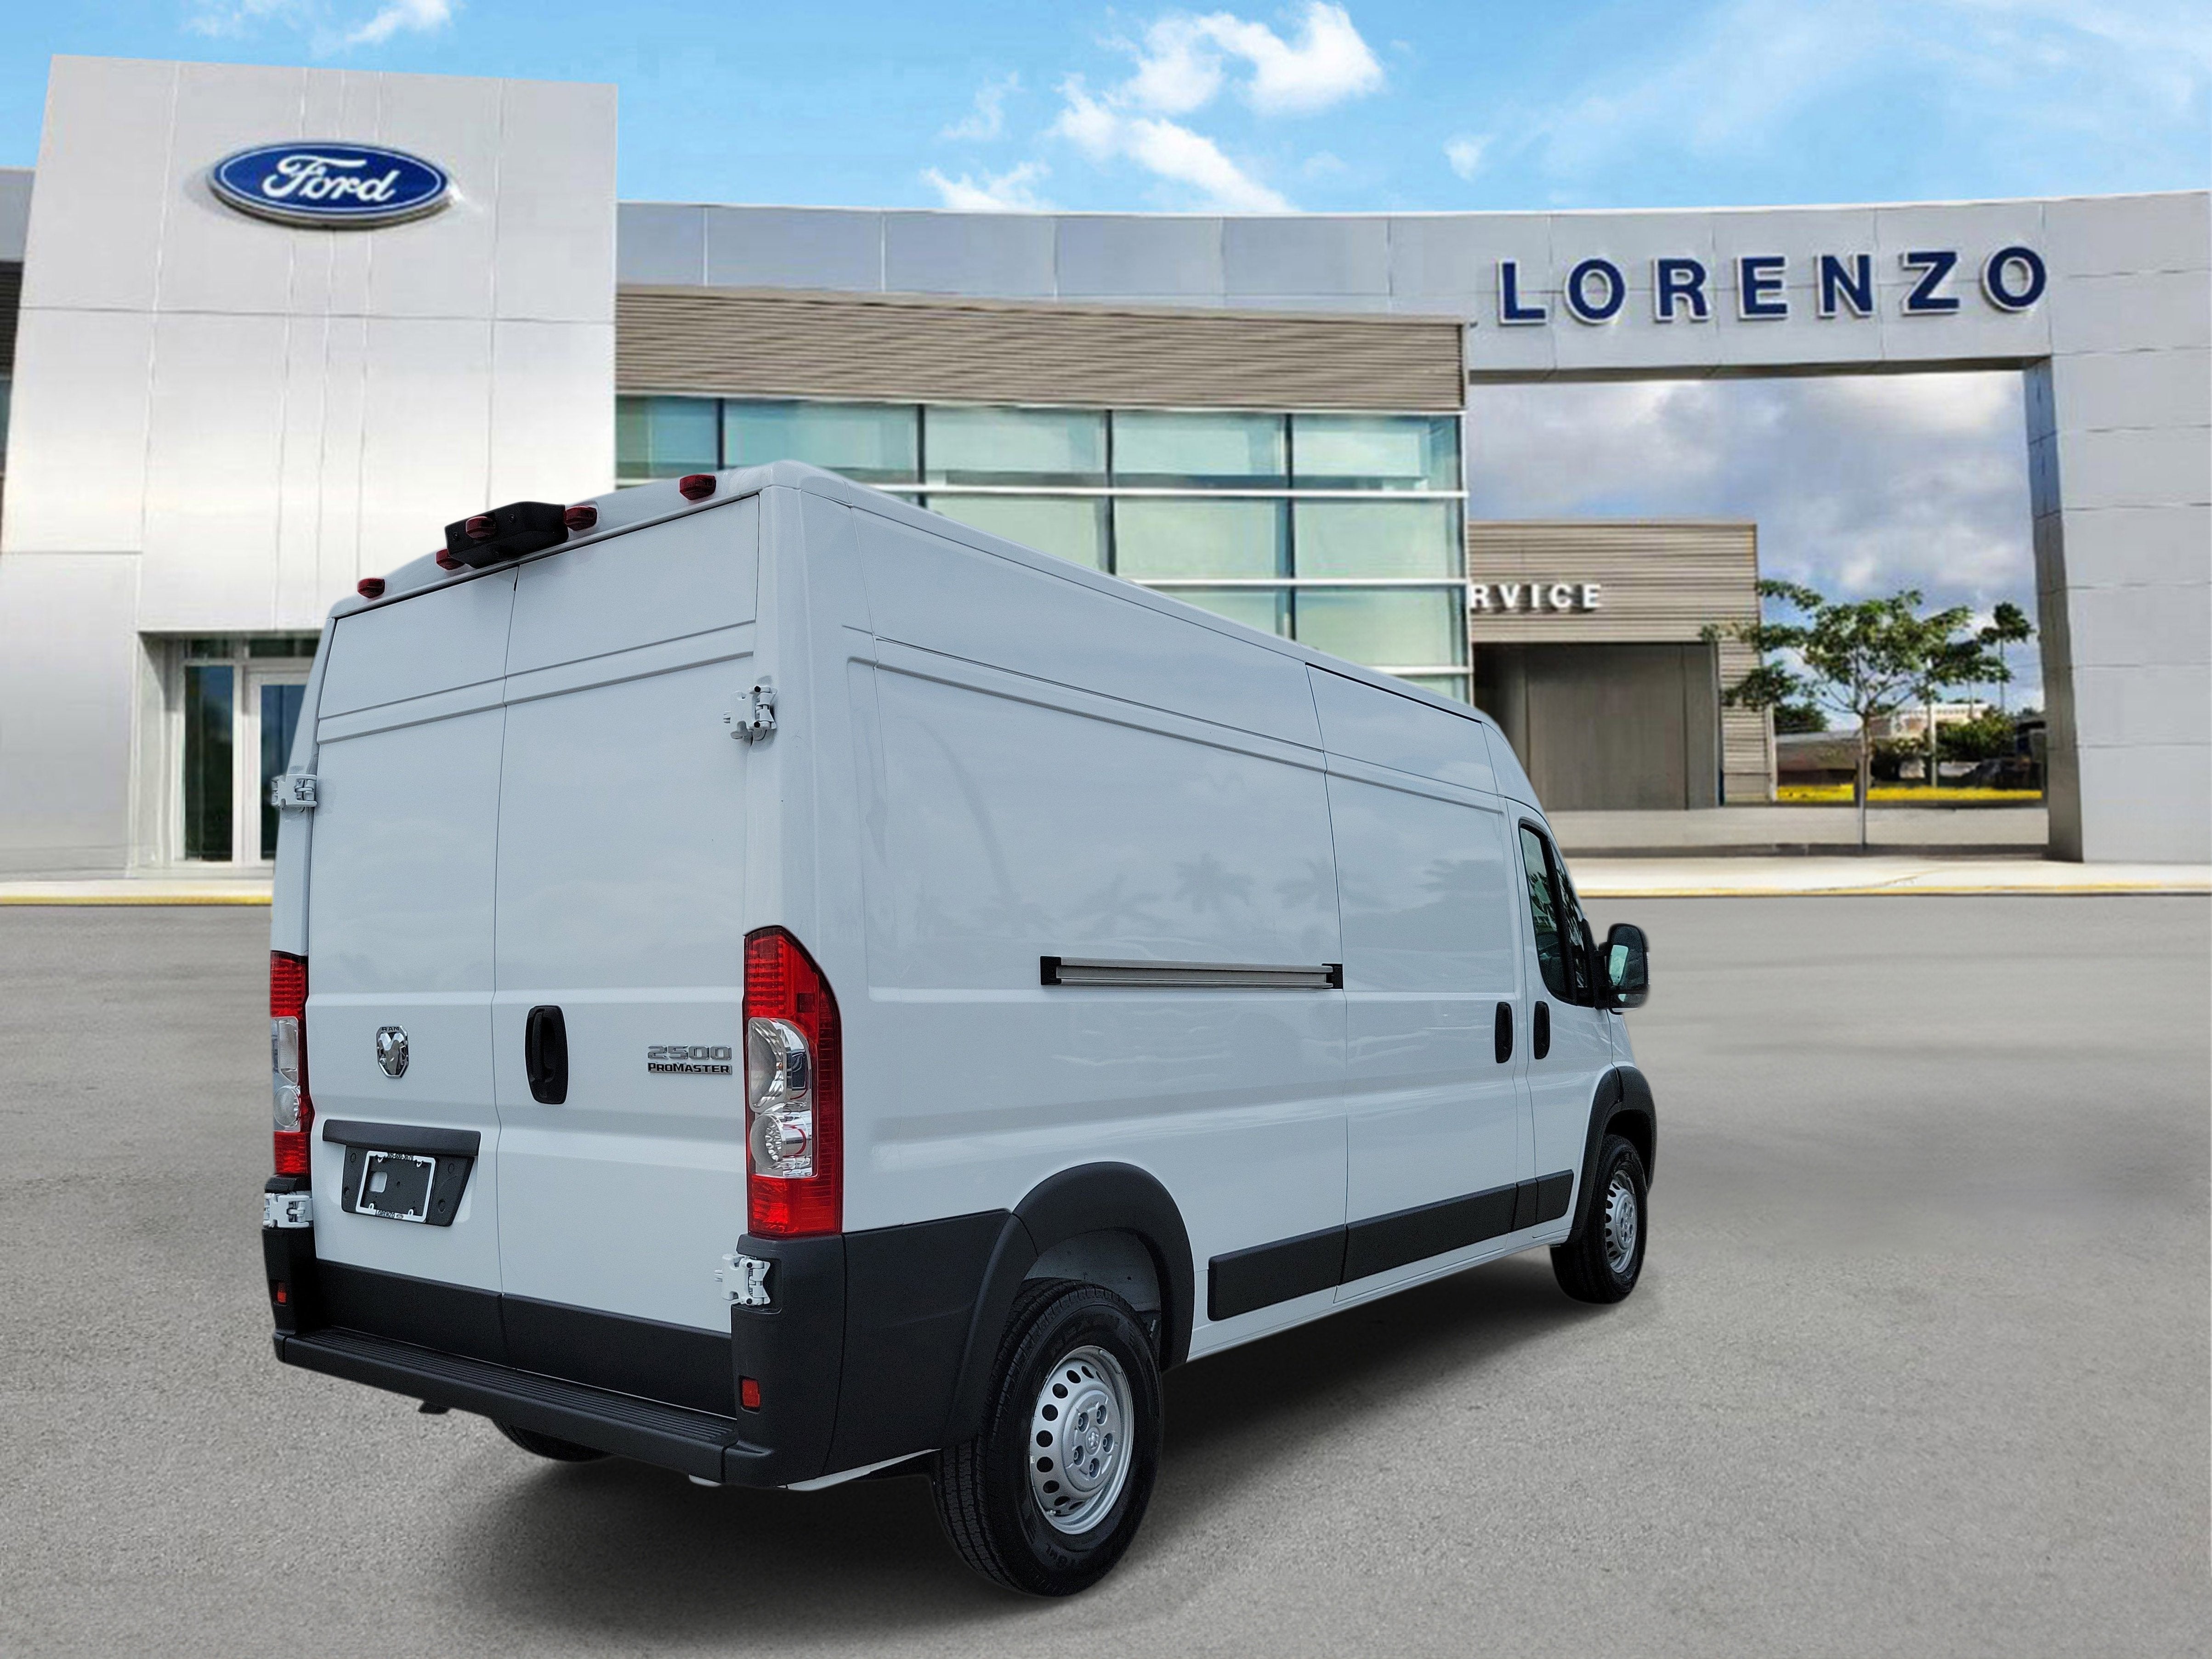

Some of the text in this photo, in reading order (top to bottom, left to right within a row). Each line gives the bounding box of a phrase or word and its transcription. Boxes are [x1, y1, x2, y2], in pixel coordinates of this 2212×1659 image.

[262, 154, 401, 201] Ford
[1499, 246, 2048, 324] LORENZO
[647, 1046, 732, 1060] 2500
[375, 1209, 395, 1218] LORENZO
